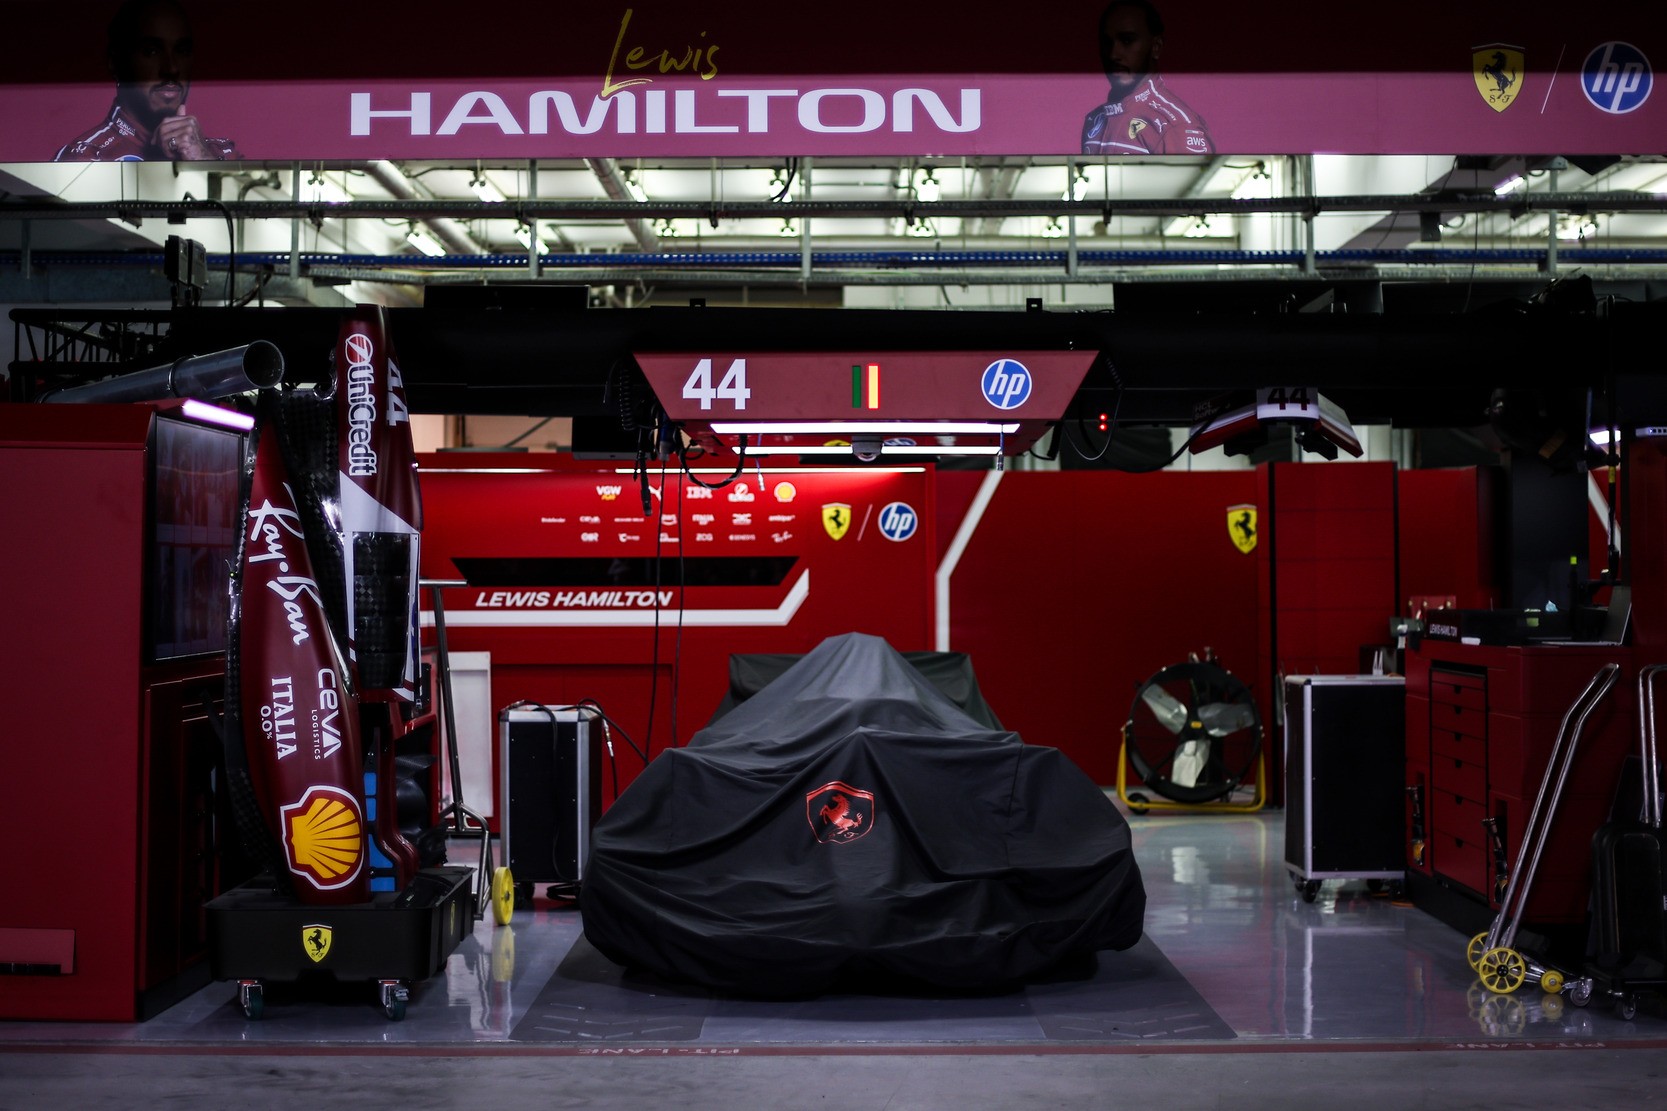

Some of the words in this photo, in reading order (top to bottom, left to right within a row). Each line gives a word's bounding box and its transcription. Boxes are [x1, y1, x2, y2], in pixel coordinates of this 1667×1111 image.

[600, 8, 720, 97] Lewis
[1591, 42, 1645, 111] hp
[350, 87, 982, 137] HAMILTON
[1186, 136, 1206, 147] aws
[386, 356, 409, 427] 44
[682, 358, 751, 410] 44
[987, 360, 1027, 409] hp
[1267, 388, 1310, 411] 44
[347, 362, 377, 477] UniCredit
[883, 503, 913, 541] hp
[475, 591, 550, 607] LEWIS
[553, 591, 673, 607] HAMILTON
[260, 705, 273, 740] 0.0%
[271, 676, 298, 760] ITALIA
[311, 709, 321, 760] LOGISTICS
